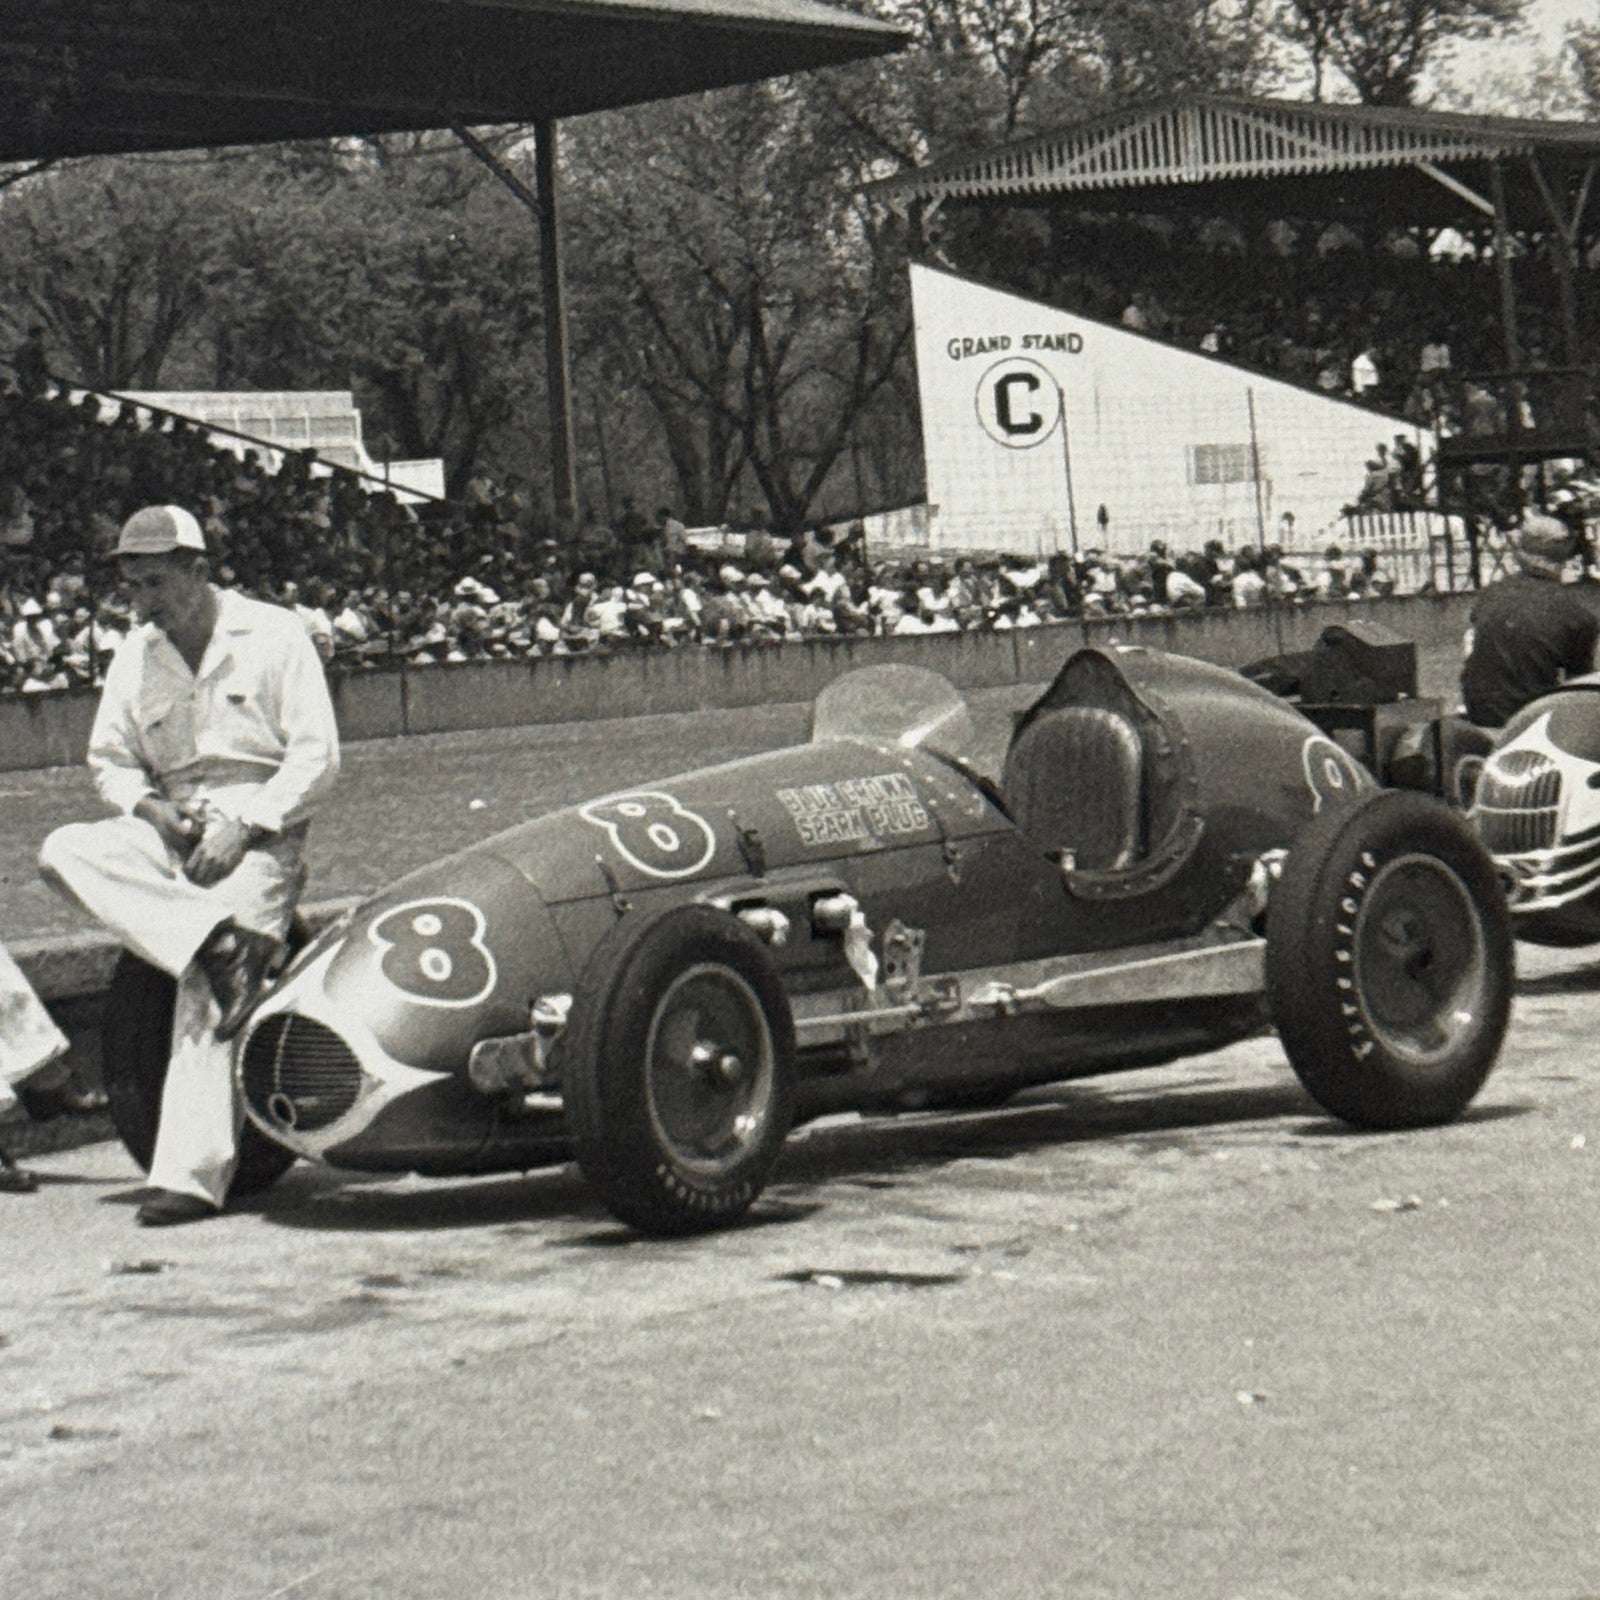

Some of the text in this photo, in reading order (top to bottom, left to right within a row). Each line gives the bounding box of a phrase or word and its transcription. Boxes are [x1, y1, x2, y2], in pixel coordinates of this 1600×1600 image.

[947, 332, 1084, 360] GRAND STAND
[994, 372, 1043, 436] C
[579, 790, 716, 878] 8
[798, 800, 929, 847] SPARK PLUG
[366, 896, 497, 1008] 8
